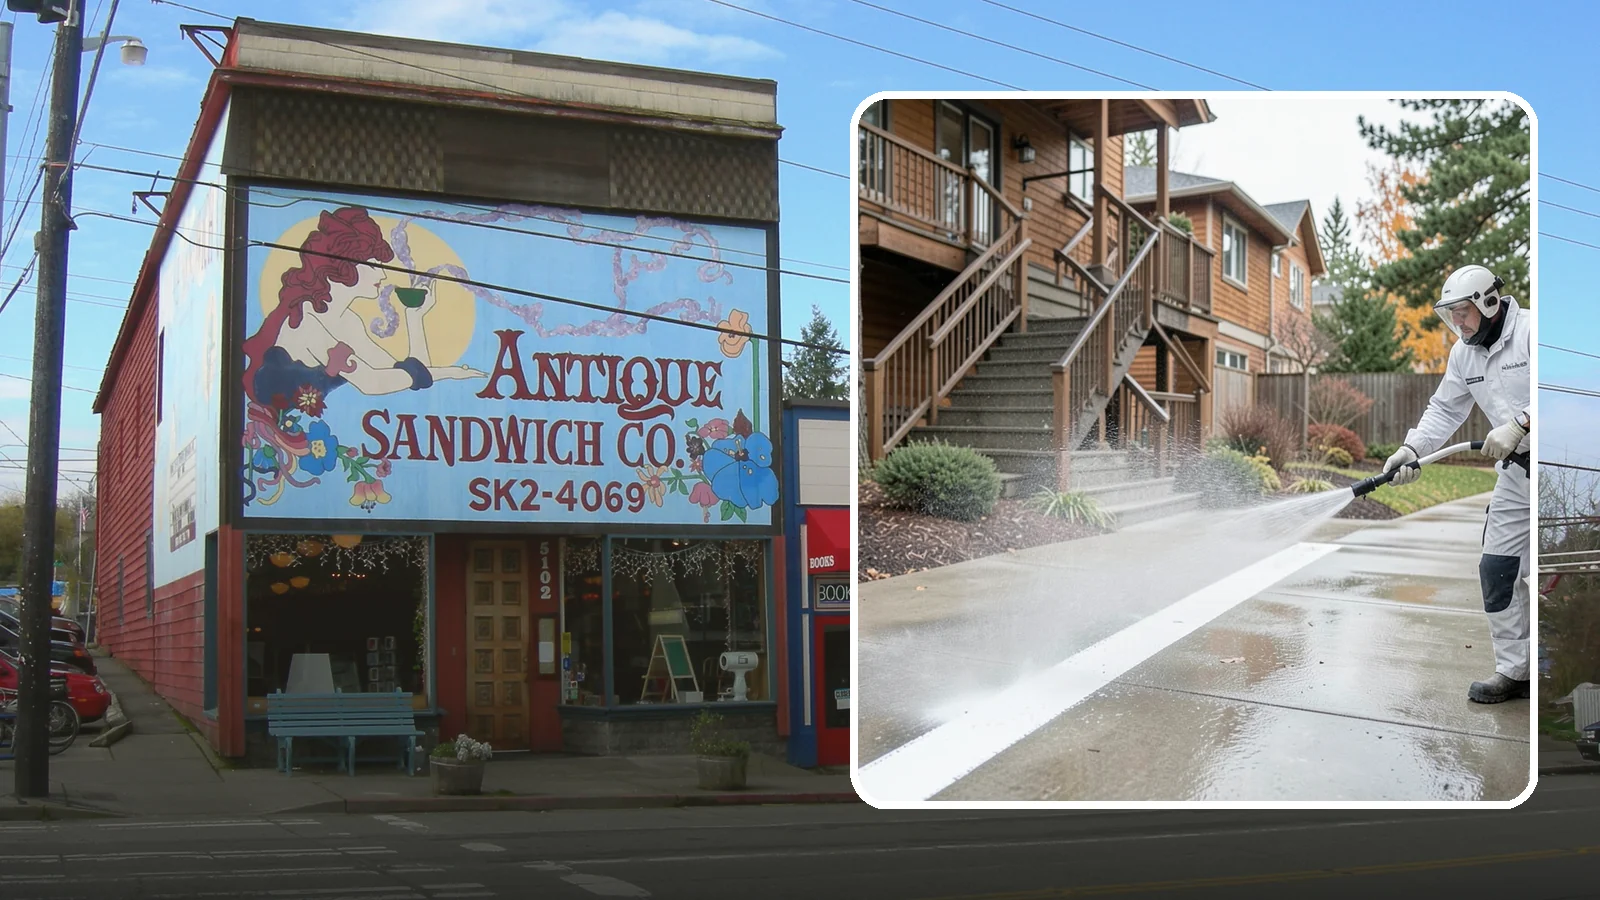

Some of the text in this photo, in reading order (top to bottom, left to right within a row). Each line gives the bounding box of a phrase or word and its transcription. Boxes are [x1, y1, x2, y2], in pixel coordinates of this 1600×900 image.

[475, 328, 724, 421] ANTIQUE
[361, 408, 685, 469] SANDWICH CO.
[468, 476, 646, 513] SK2-4069
[539, 541, 552, 600] 5102
[809, 554, 835, 569] BOOKS
